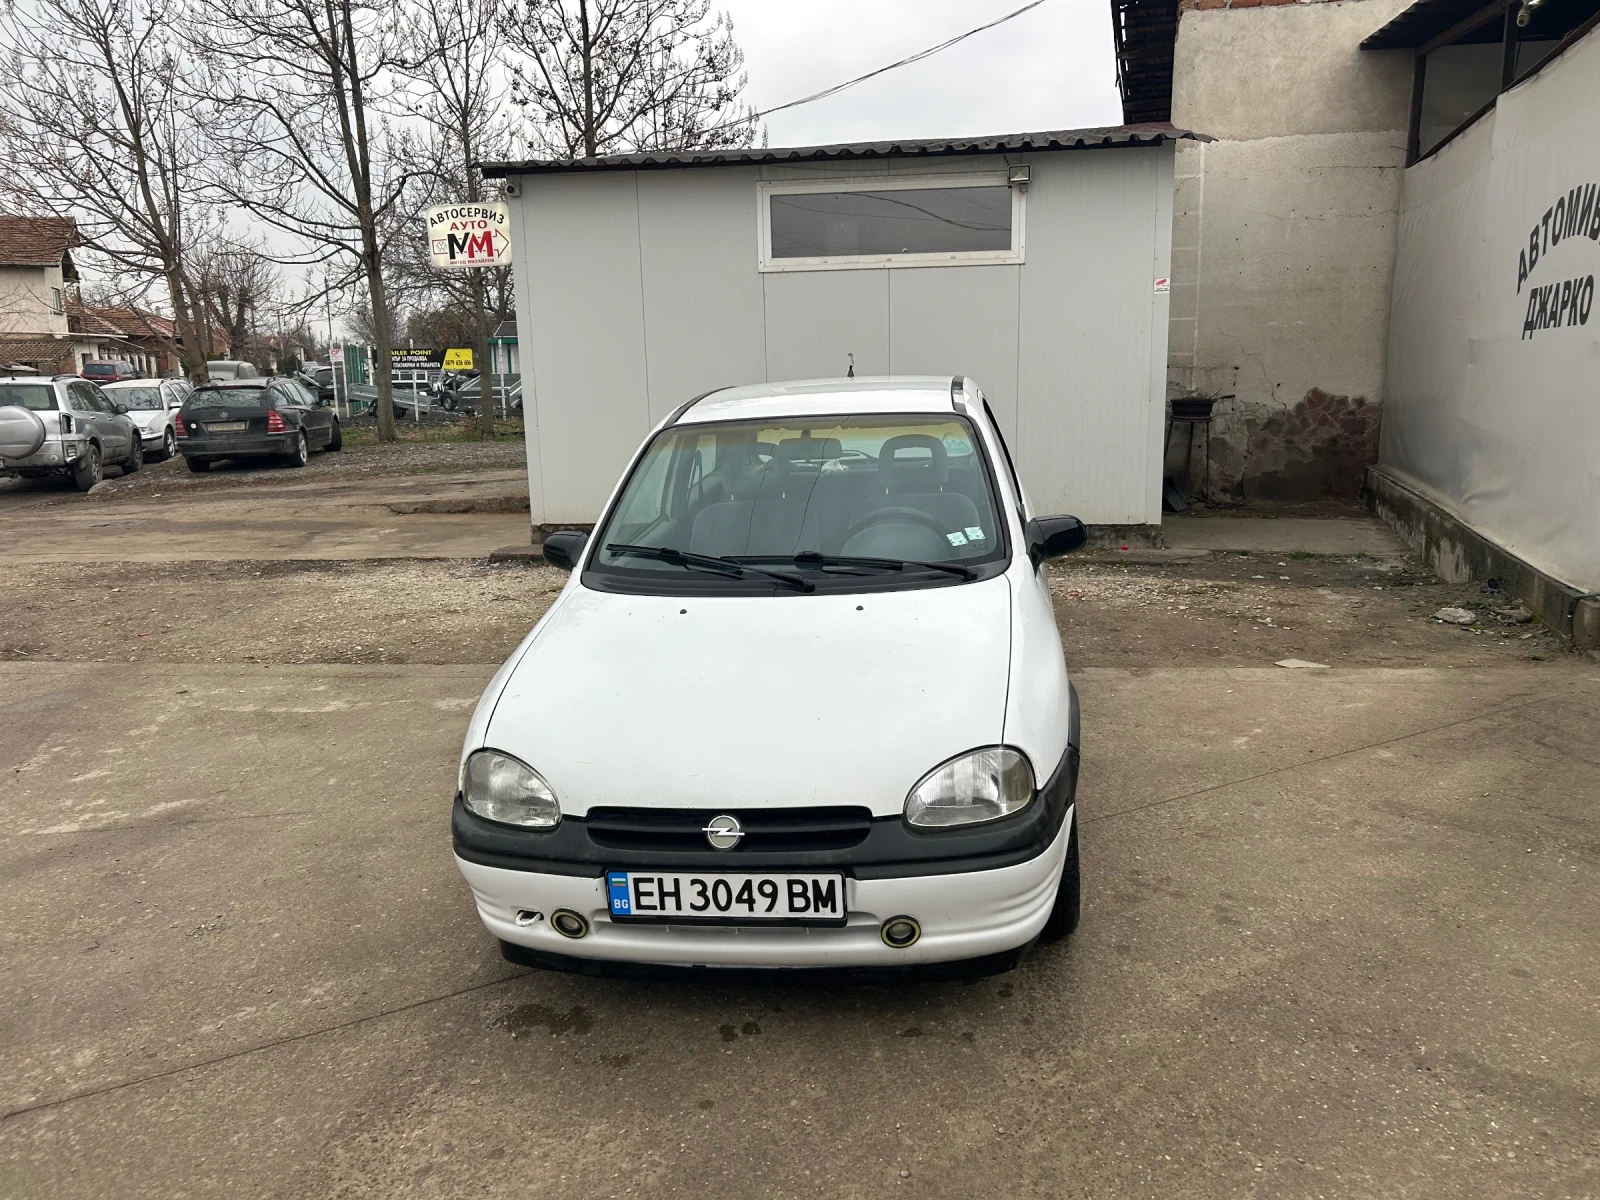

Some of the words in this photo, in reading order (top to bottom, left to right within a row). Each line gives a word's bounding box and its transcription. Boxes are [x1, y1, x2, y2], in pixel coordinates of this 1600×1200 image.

[430, 207, 505, 227] АВТОСЕРВИЗ
[450, 220, 488, 231] АУТО
[1522, 275, 1594, 340] ДЖАРКО
[614, 899, 629, 909] BG
[633, 877, 682, 911] EH
[689, 879, 778, 912] 3049
[787, 879, 837, 913] BM
